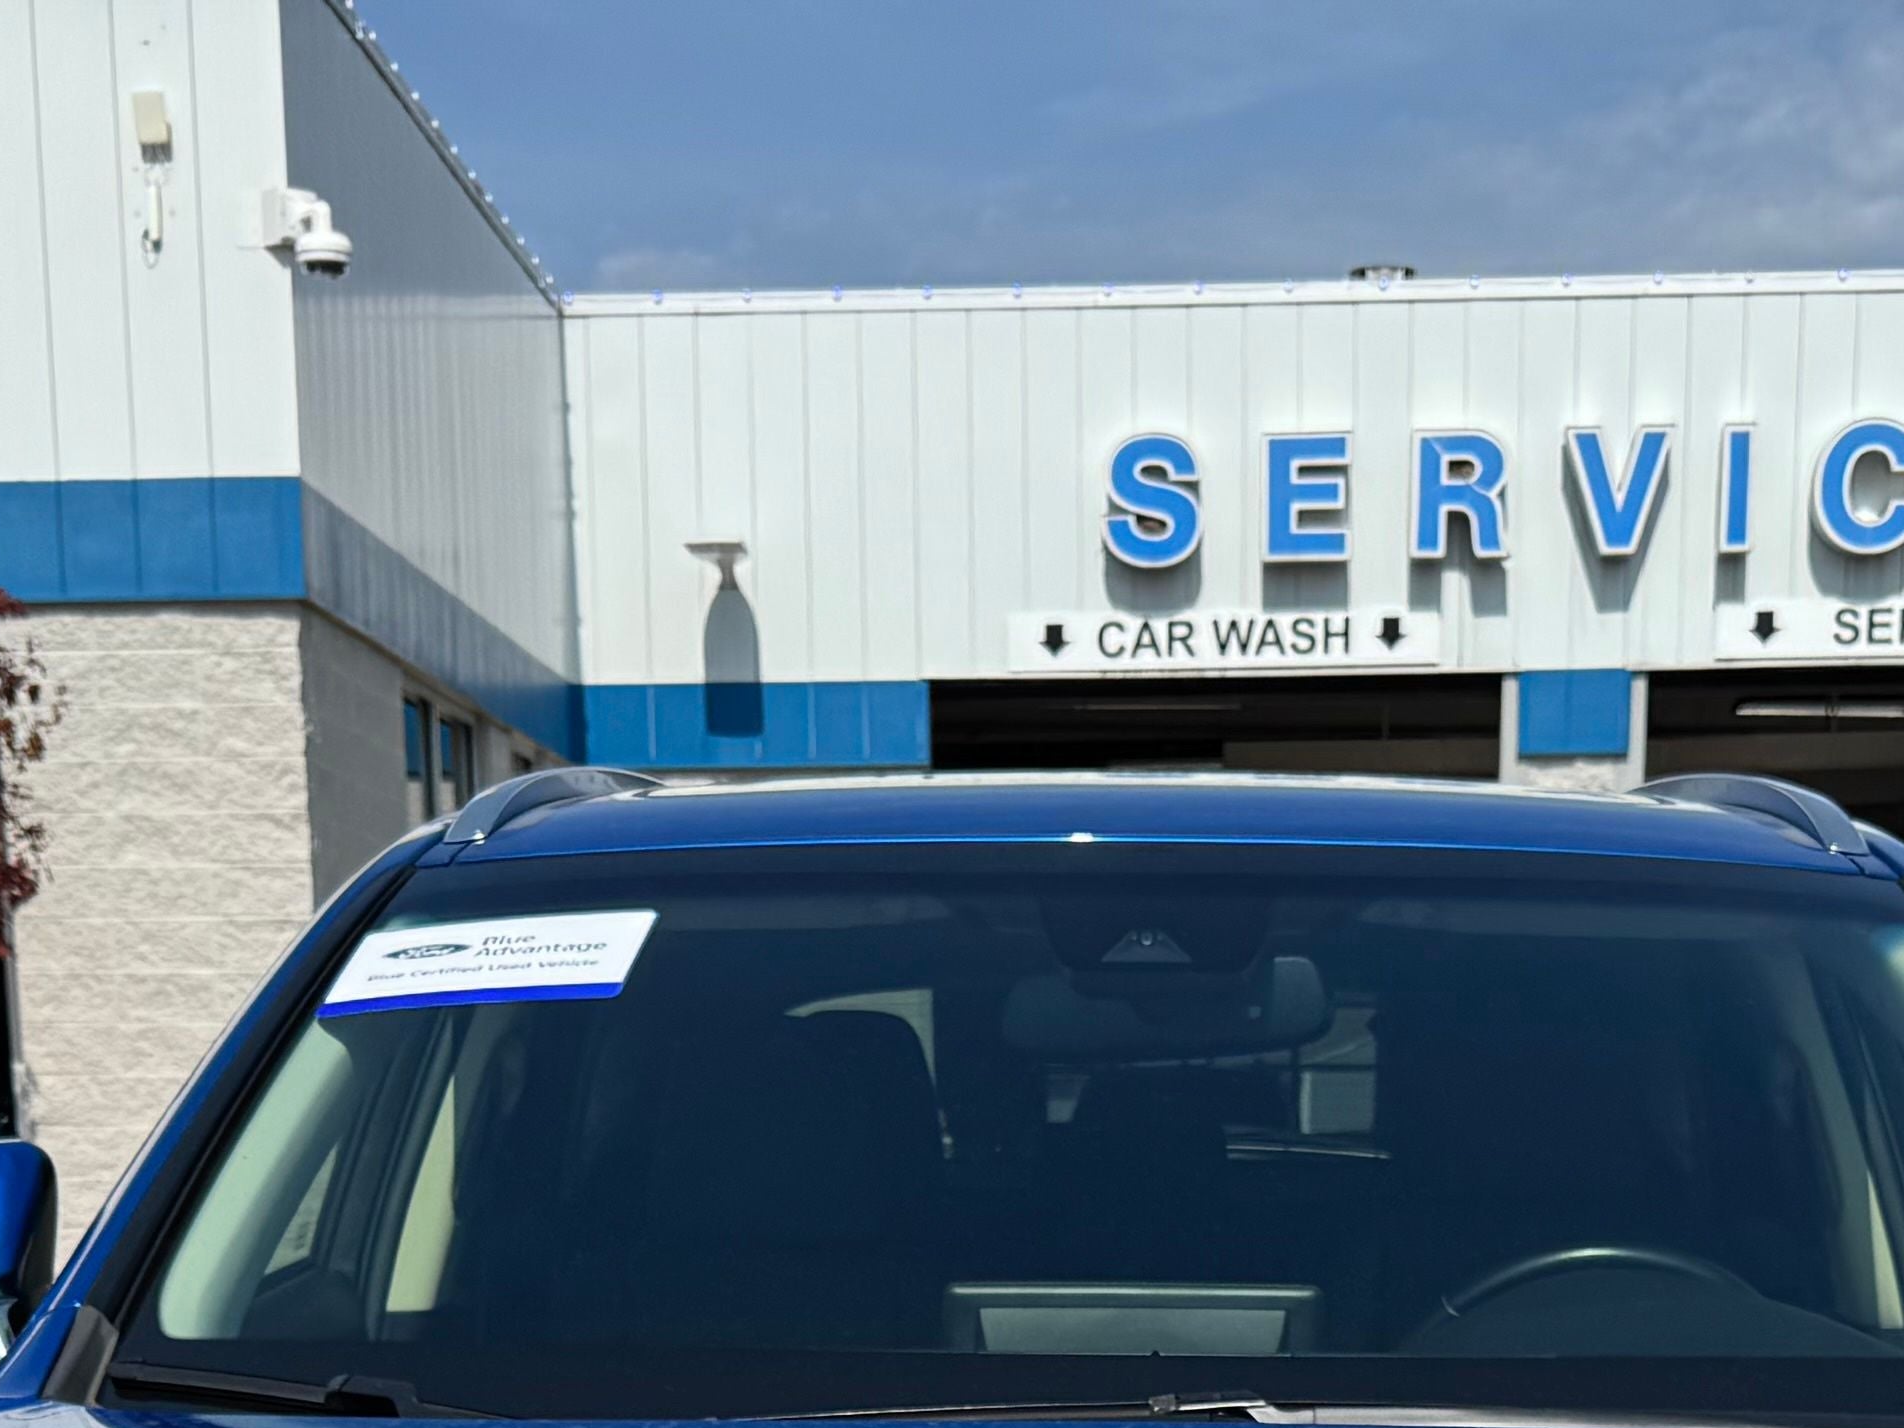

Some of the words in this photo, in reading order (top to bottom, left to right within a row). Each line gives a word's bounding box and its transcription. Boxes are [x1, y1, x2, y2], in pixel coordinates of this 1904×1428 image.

[1097, 619, 1196, 660] CAR
[1212, 616, 1352, 657] WASH
[473, 941, 608, 958] Advantage
